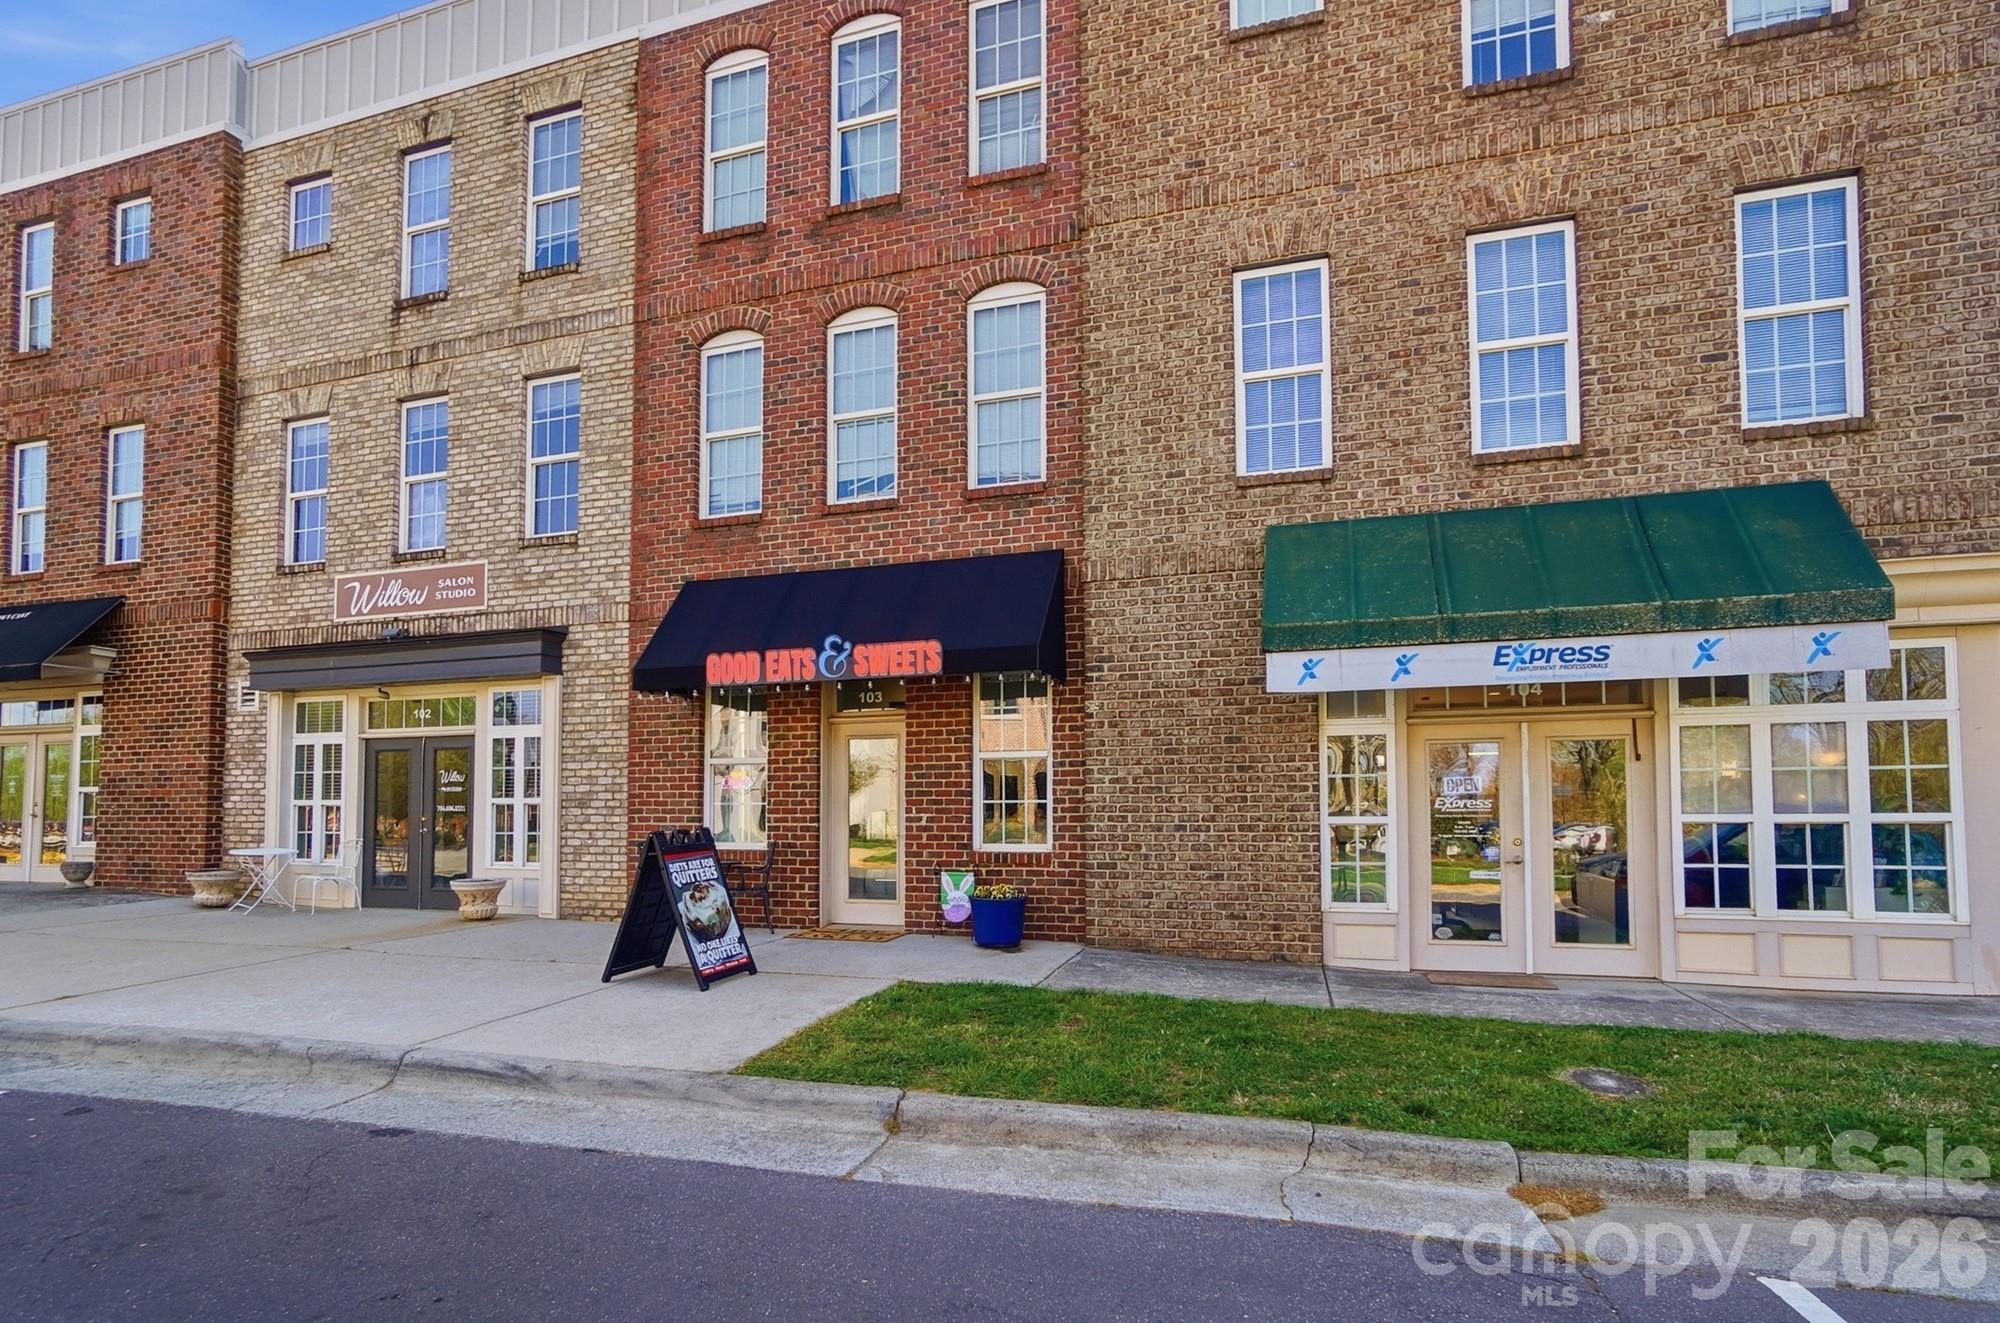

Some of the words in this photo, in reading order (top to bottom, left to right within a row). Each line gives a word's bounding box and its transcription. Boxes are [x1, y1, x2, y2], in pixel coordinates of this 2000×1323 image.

[438, 576, 474, 588] SALON
[344, 576, 429, 615] Willow
[435, 588, 476, 600] STUDIO
[706, 650, 761, 685] GOOD
[765, 647, 817, 682] EATS
[818, 634, 852, 679] &
[853, 638, 943, 677] SWEETS
[1506, 684, 1542, 696] 104
[858, 691, 883, 703] 103
[413, 708, 432, 719] 102
[1446, 778, 1480, 793] OPEN
[668, 862, 689, 873] DIETS
[689, 859, 702, 870] ARE
[701, 857, 715, 868] FOR
[671, 867, 718, 887] QUITTERS
